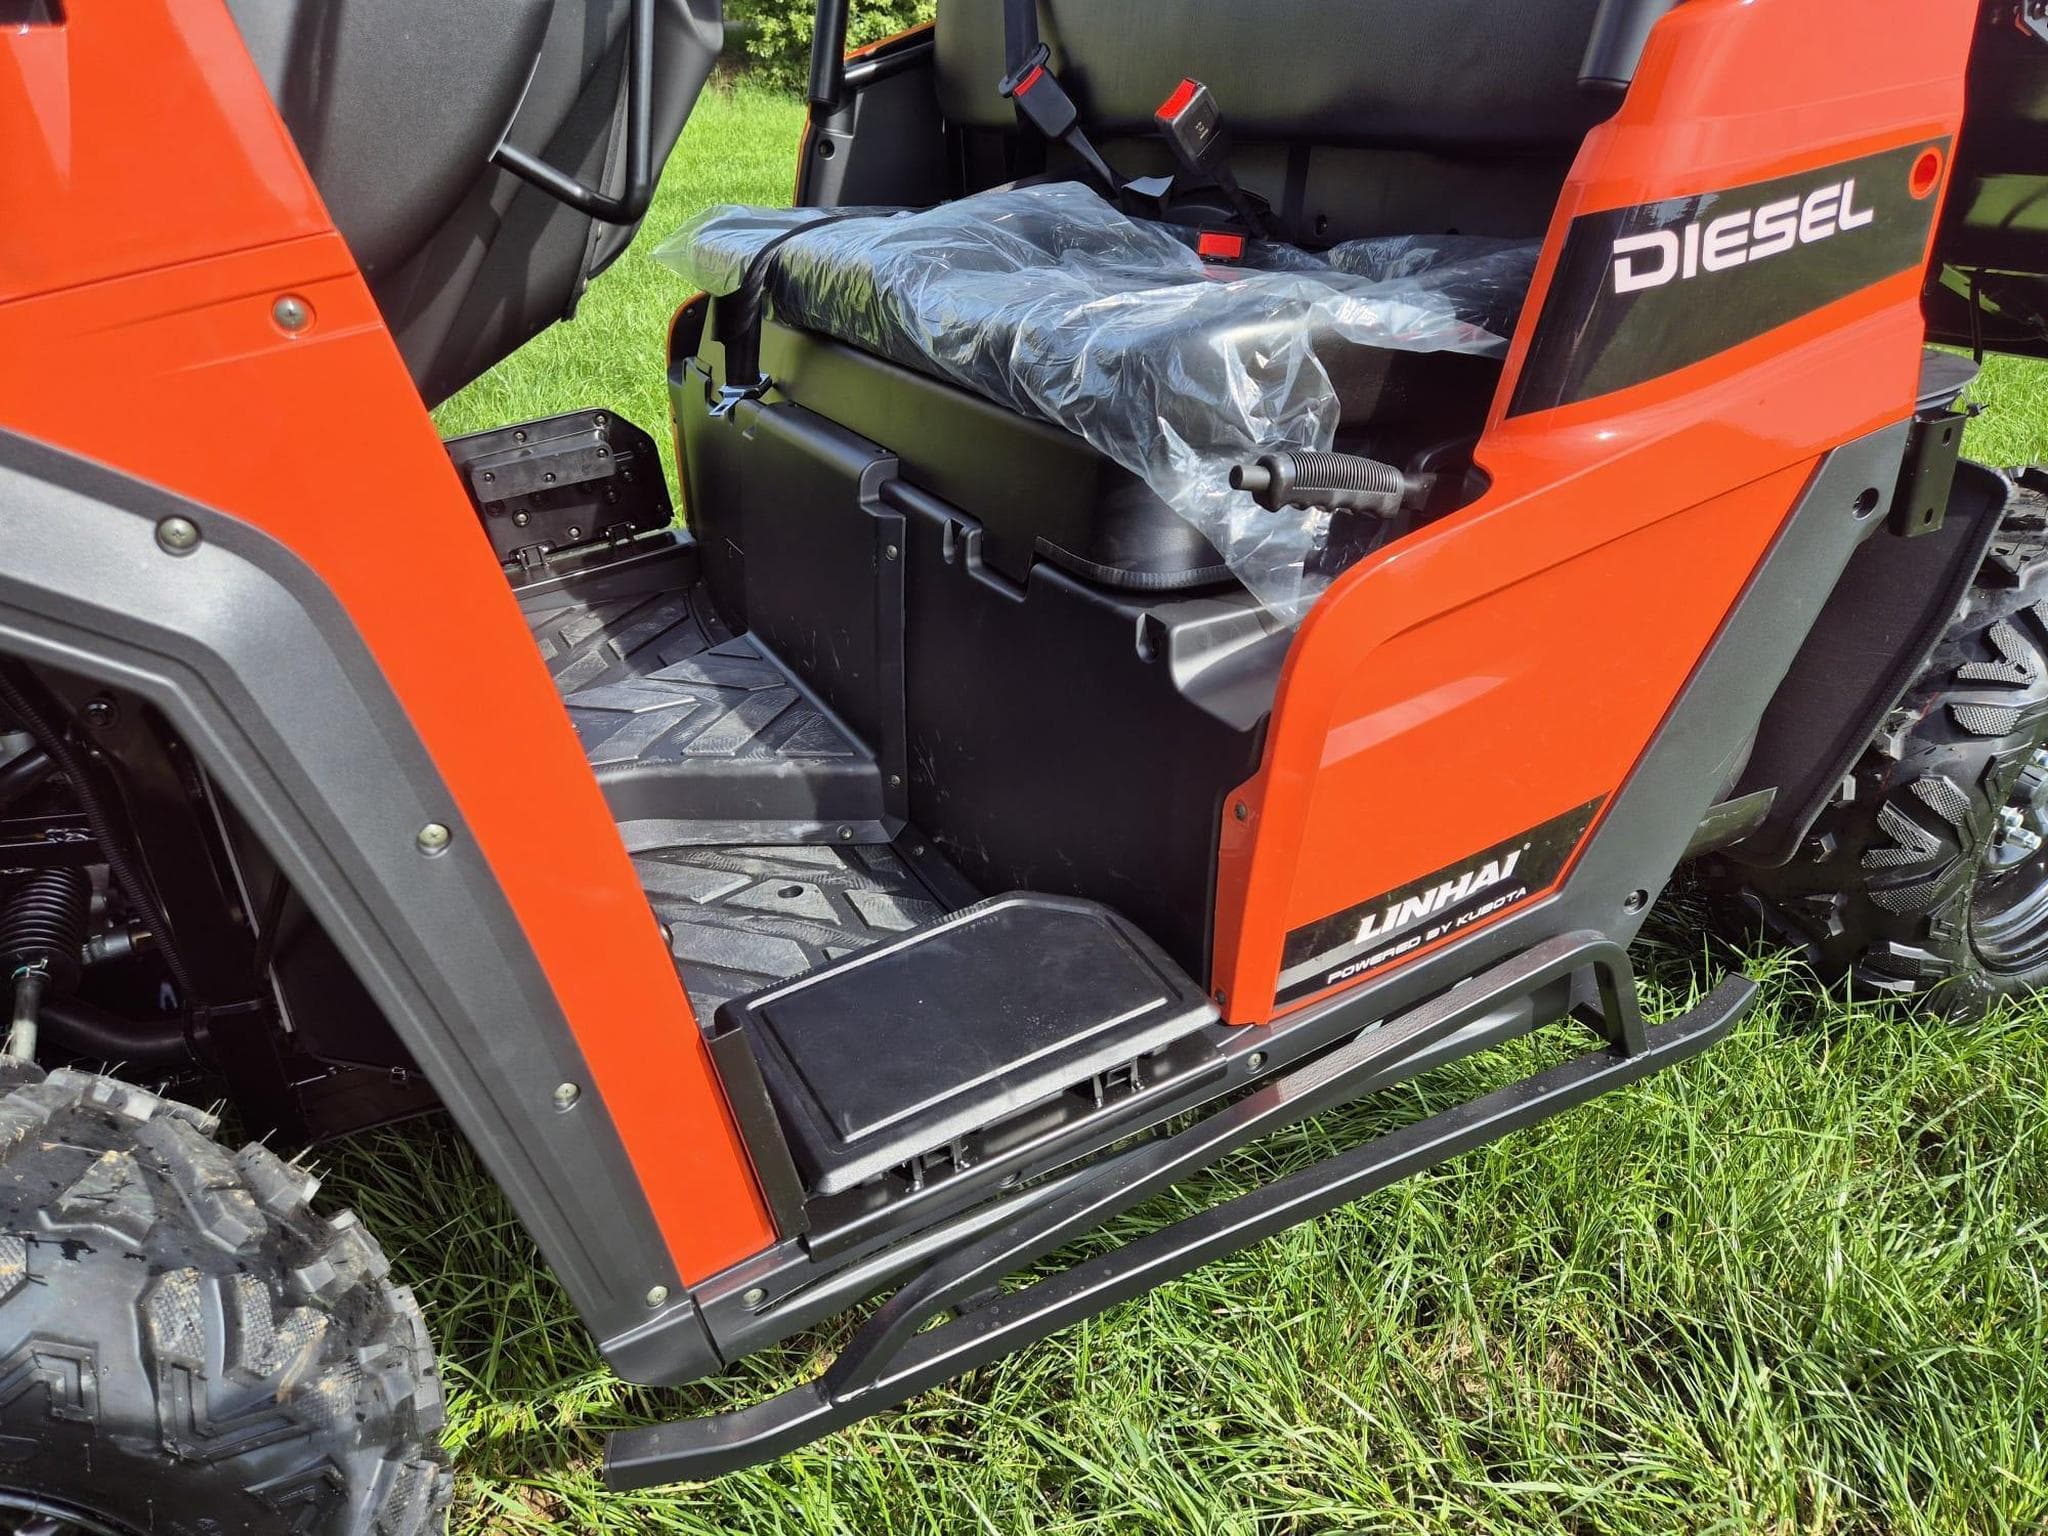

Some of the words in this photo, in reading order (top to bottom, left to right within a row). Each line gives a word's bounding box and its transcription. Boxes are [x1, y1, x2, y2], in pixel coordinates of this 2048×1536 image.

[1613, 179, 1874, 293] DIESEL
[1327, 936, 1421, 984] POWERED
[1426, 921, 1453, 941] BY
[1456, 887, 1527, 927] KUBOTA
[1355, 849, 1521, 945] LINHAI
